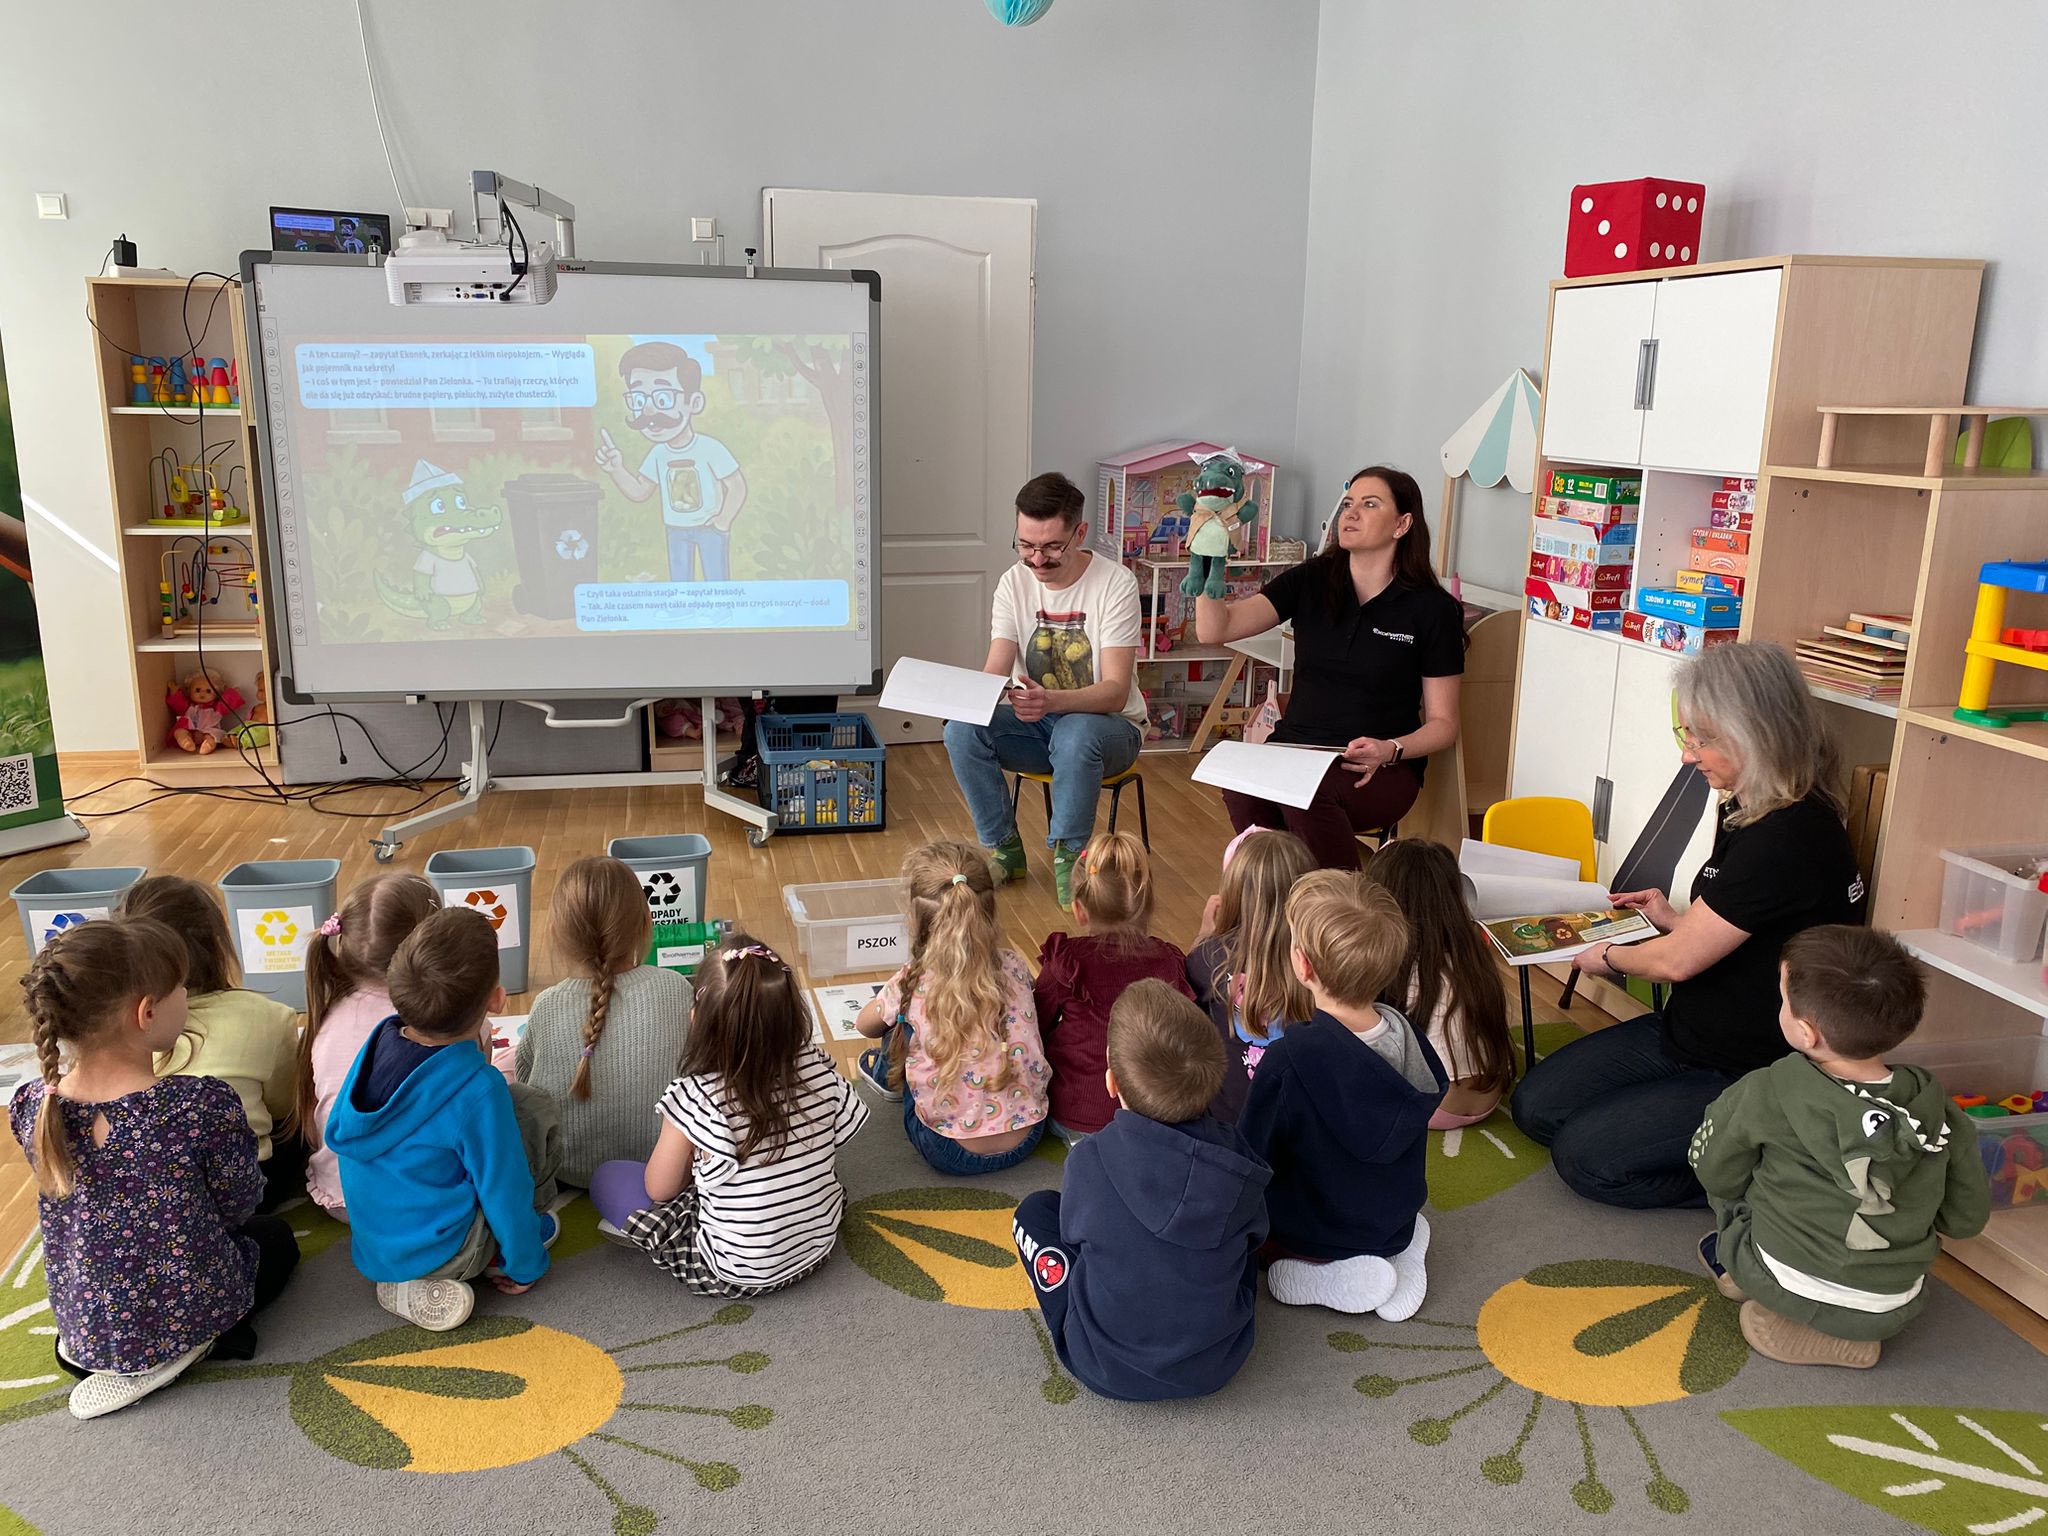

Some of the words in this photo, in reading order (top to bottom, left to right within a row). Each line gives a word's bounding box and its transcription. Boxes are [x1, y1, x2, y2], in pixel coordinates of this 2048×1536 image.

[551, 350, 585, 360] Wygląda
[1605, 573, 1620, 582] Trefl
[1680, 576, 1704, 585] symet
[1601, 596, 1616, 605] Trefl
[651, 908, 682, 919] DPADY
[857, 936, 897, 949] PSZOK
